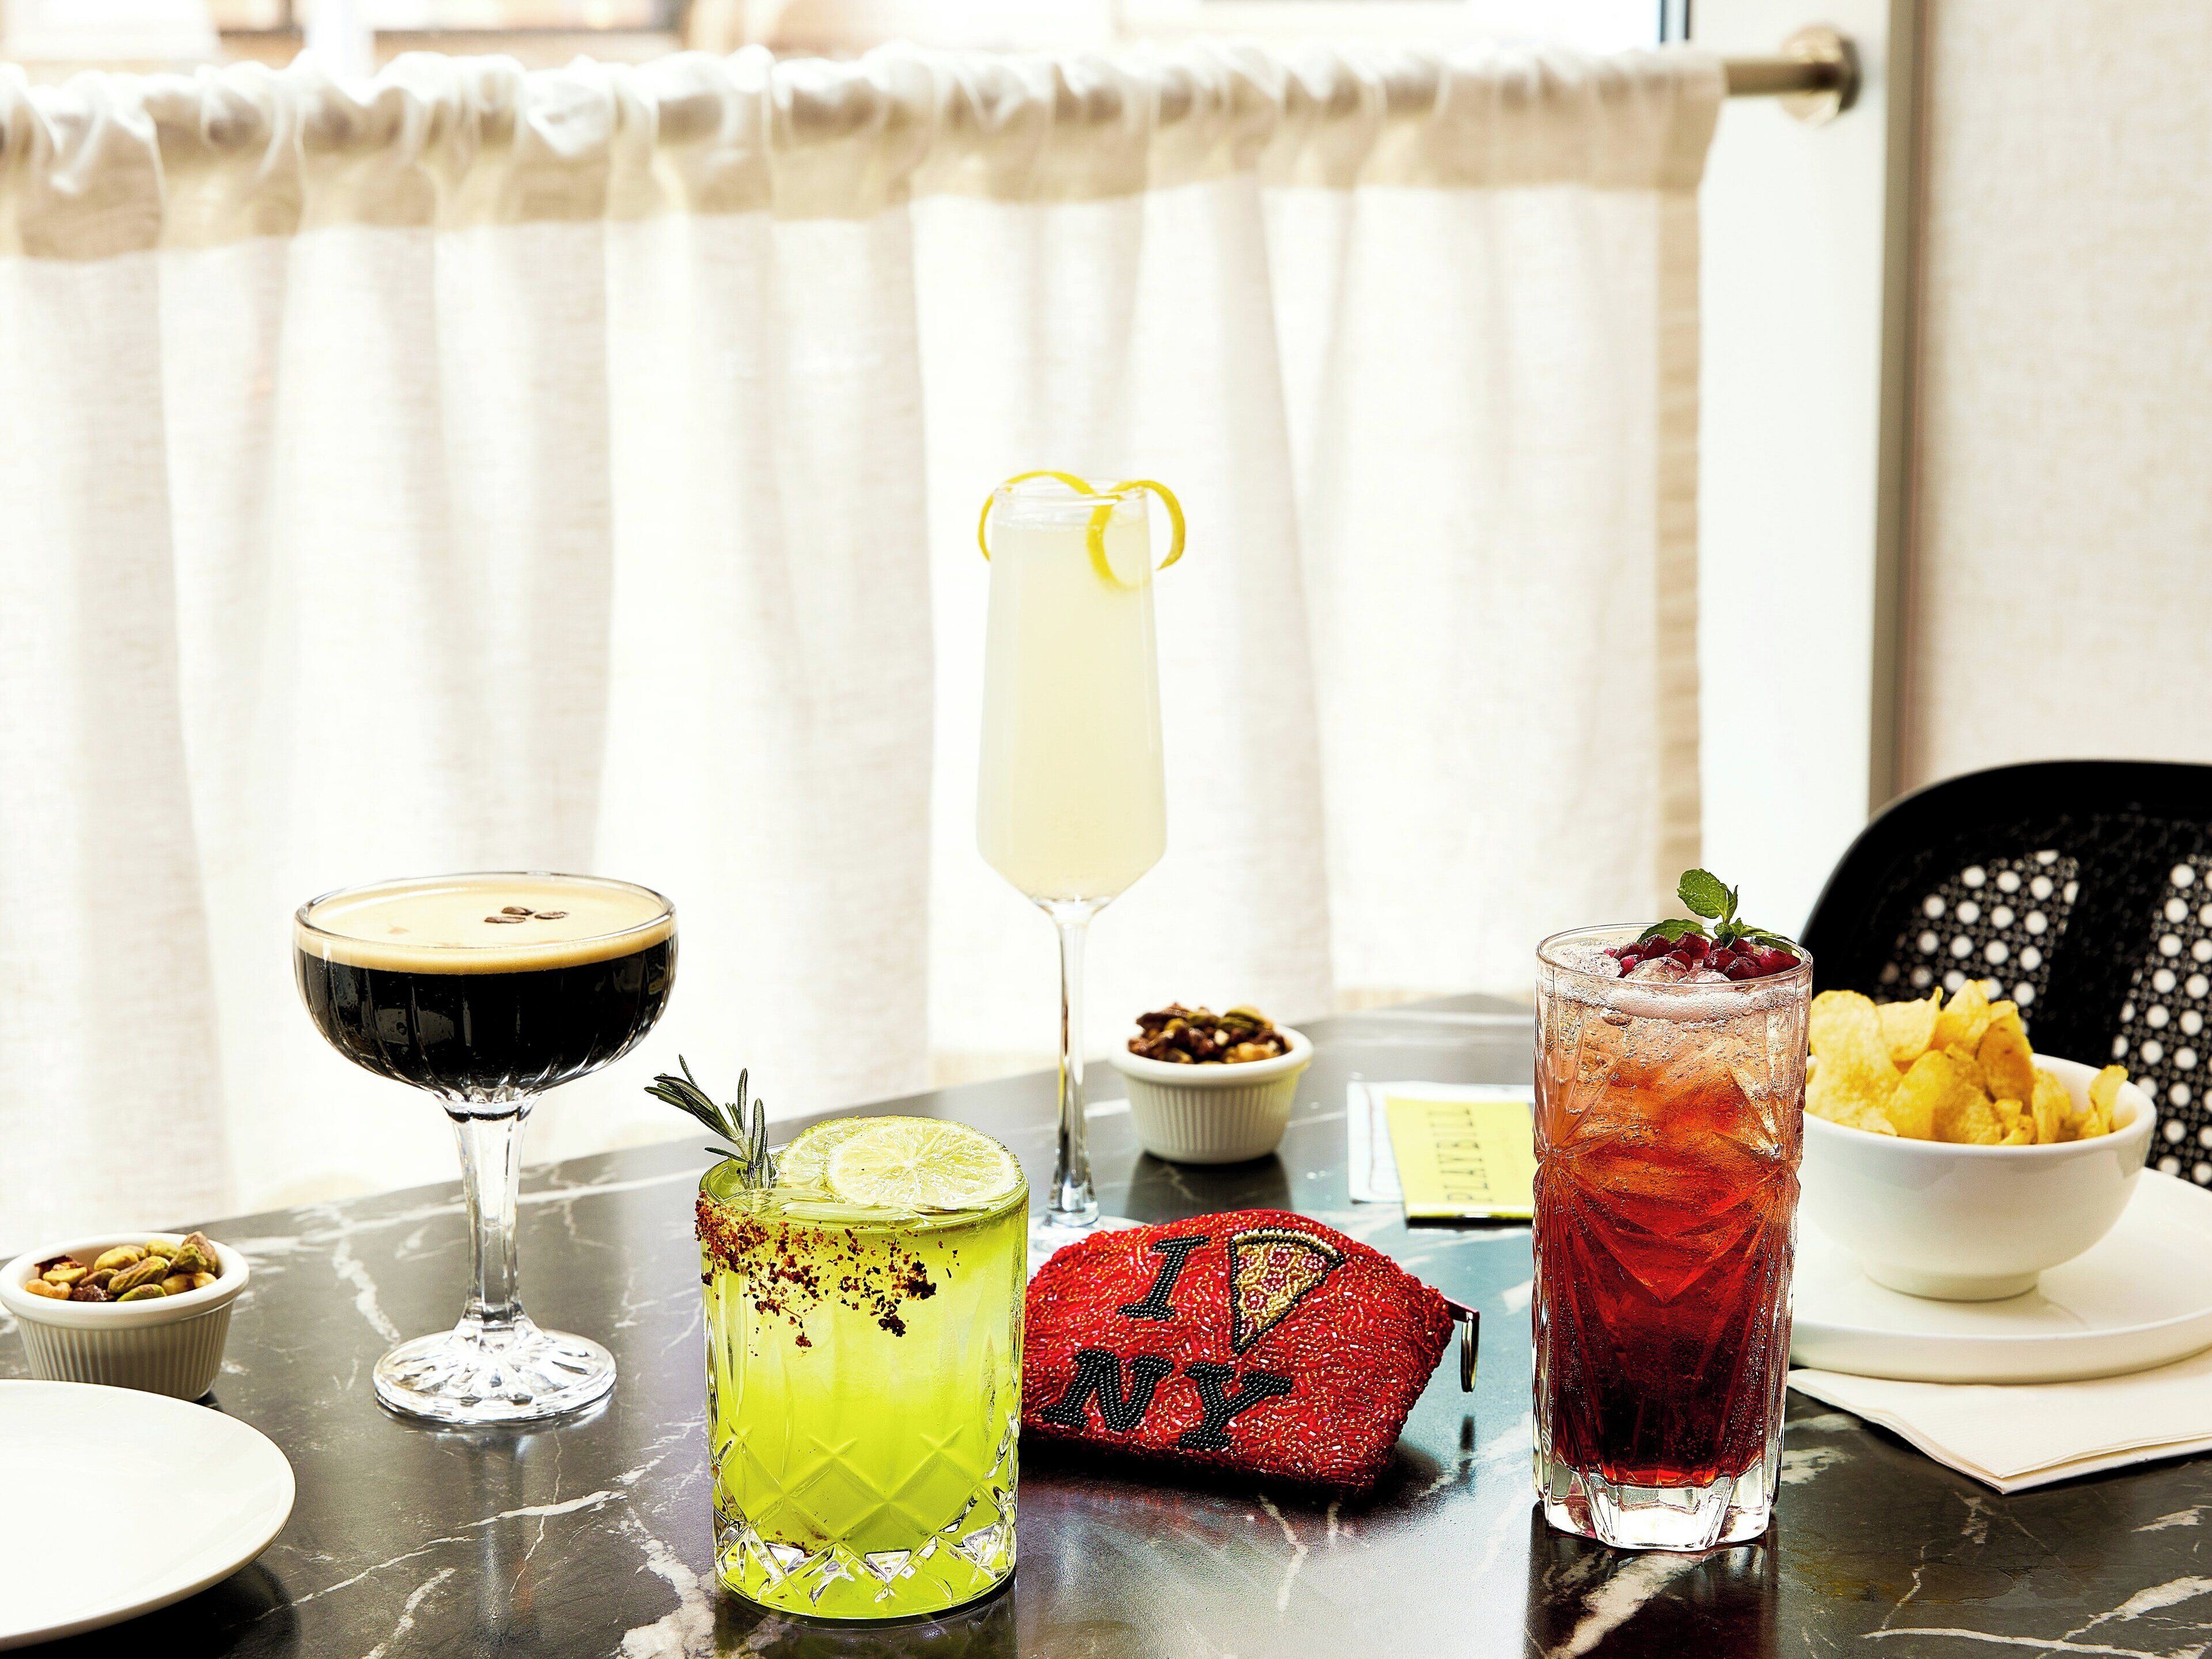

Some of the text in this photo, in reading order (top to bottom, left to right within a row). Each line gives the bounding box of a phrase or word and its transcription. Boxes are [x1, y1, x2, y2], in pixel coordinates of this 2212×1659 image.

[1427, 1107, 1493, 1202] PLAYBILL
[1118, 1236, 1211, 1320] I
[1041, 1350, 1293, 1450] NY
